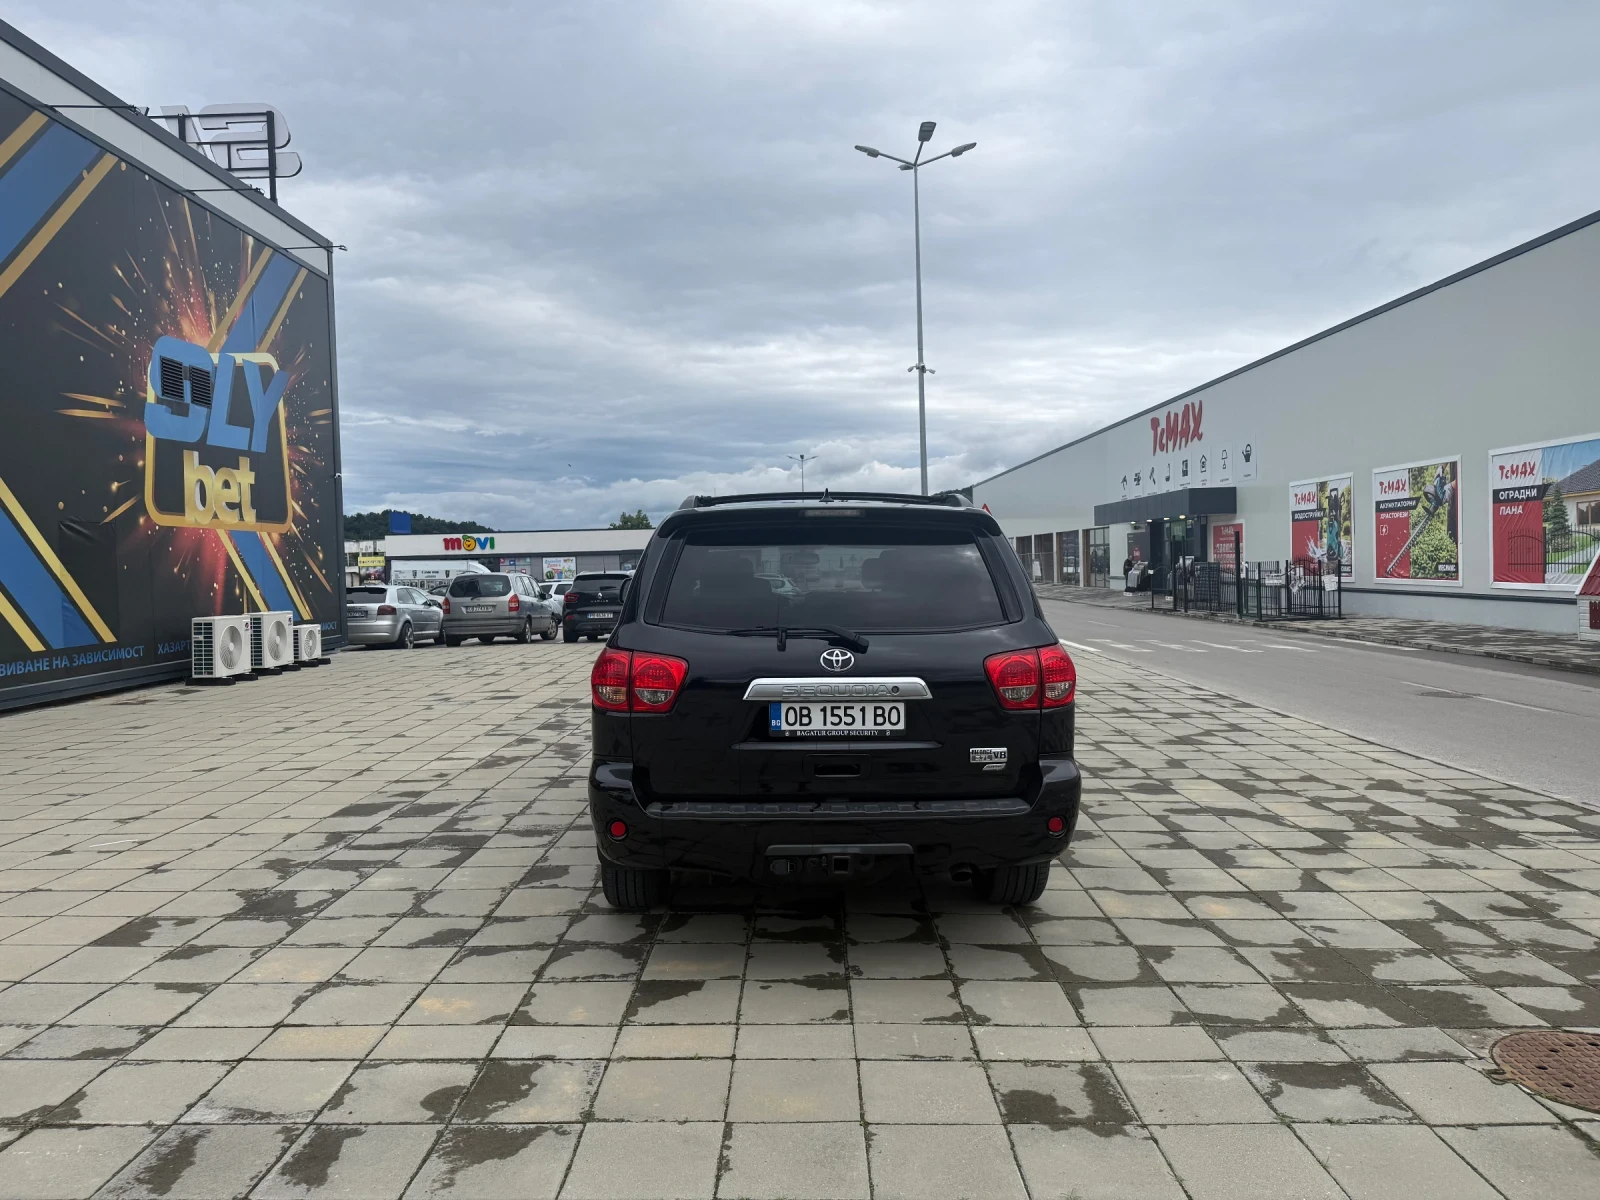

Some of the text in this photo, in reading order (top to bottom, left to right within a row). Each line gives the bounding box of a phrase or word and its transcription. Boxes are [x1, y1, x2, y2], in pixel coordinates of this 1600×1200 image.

[183, 450, 257, 524] bet
[1499, 488, 1537, 500] ОГРАДНИ
[1380, 511, 1409, 519] ХРАСТОРЕЗИ
[1500, 505, 1523, 515] ПАНА
[53, 655, 69, 669] НА
[73, 646, 144, 666] ЗАВИСИМОСТ
[782, 684, 891, 697] SEQUOIA
[820, 706, 865, 726] 1551
